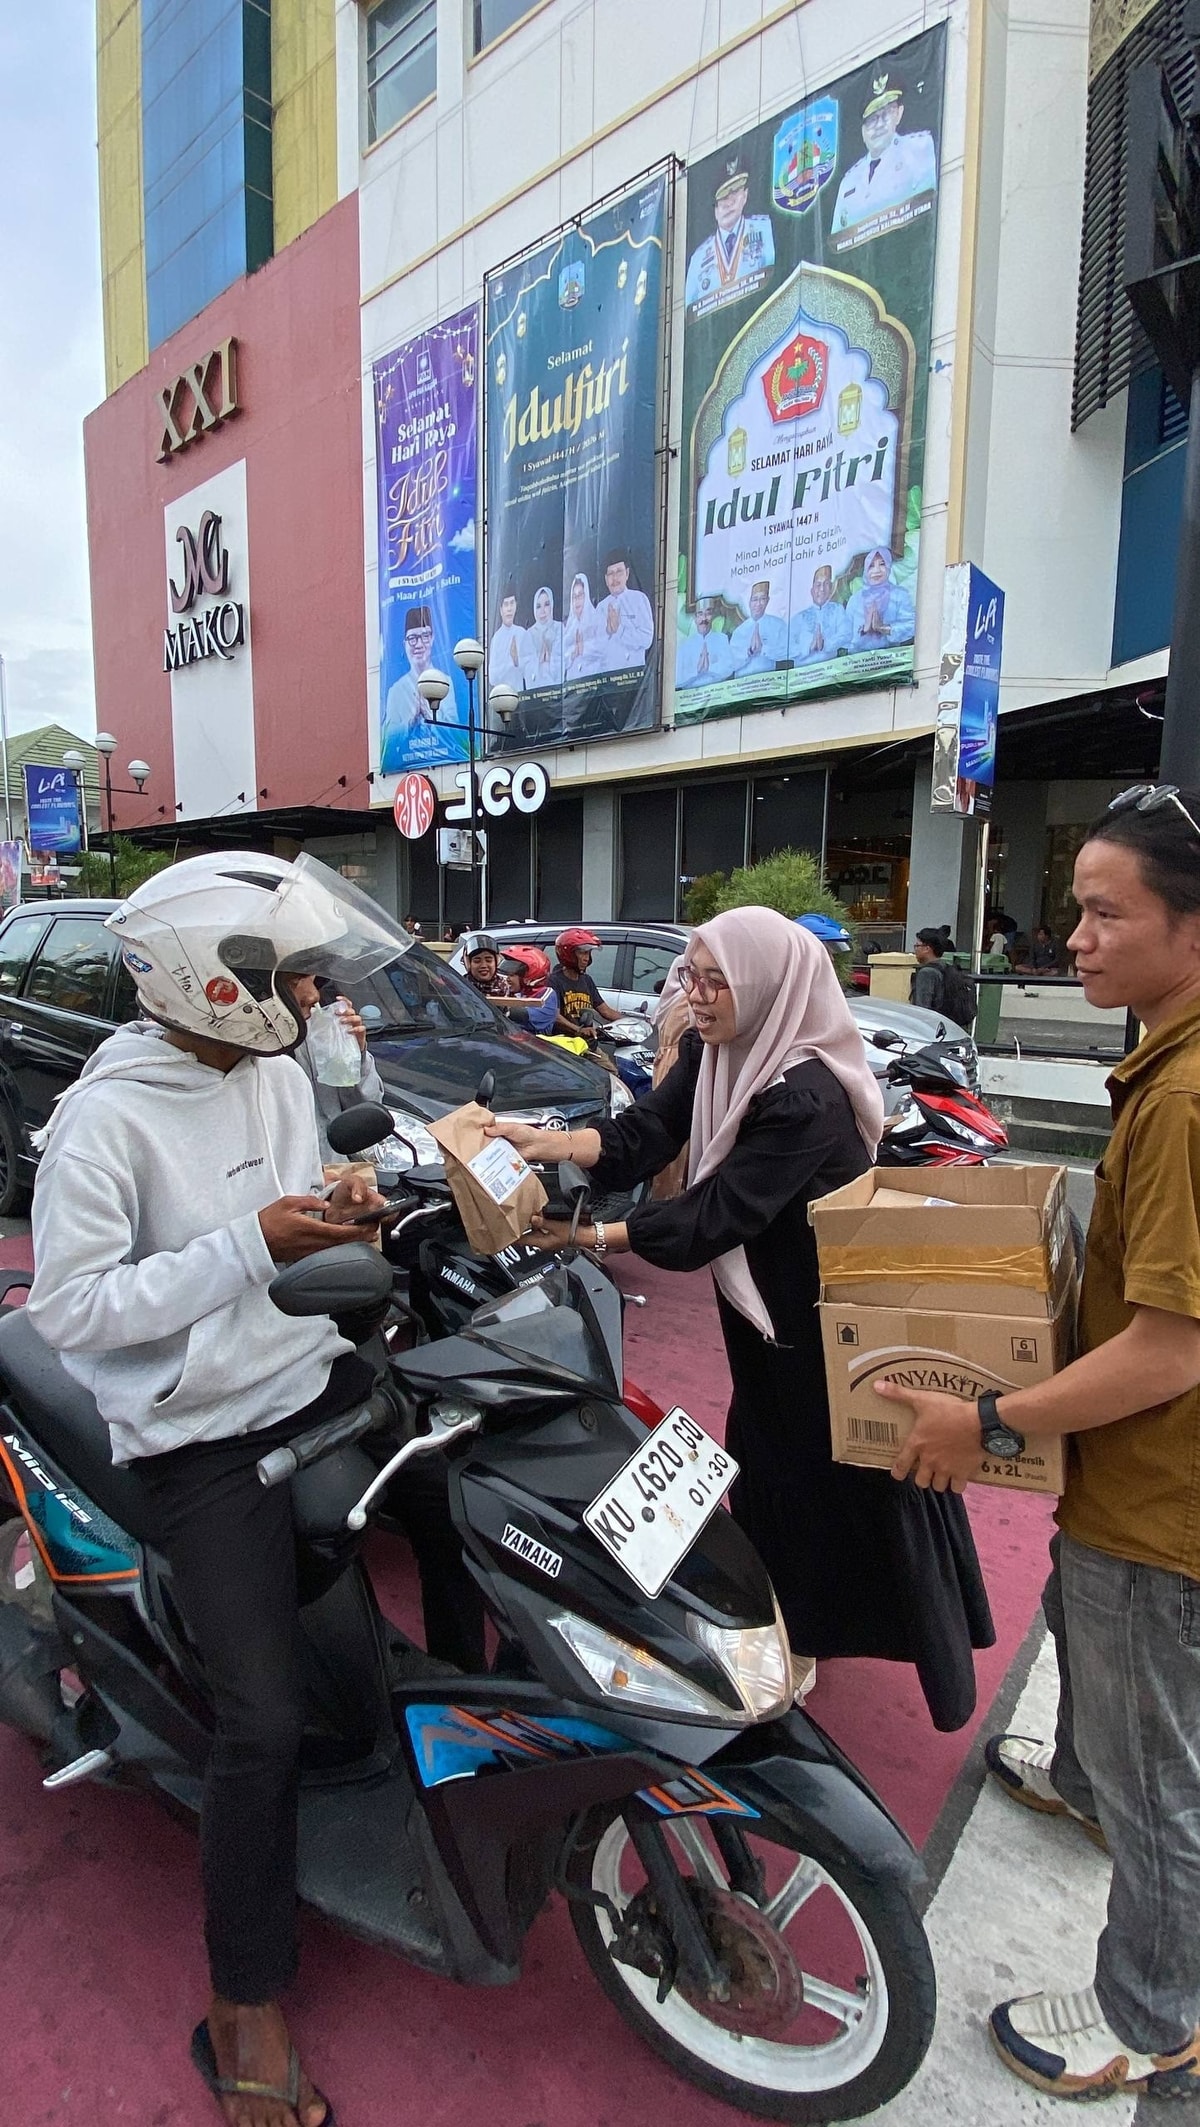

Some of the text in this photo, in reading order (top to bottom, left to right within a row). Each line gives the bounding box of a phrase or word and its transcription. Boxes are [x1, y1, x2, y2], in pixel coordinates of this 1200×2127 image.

[547, 339, 593, 370] Selamat
[153, 336, 238, 463] XXI
[503, 336, 630, 463] Idulfitri
[397, 402, 451, 442] Selamat
[391, 422, 456, 464] Hari Raya
[751, 431, 834, 472] SELAMAT HARI RAYA
[527, 455, 551, 474] Syawal
[386, 450, 448, 522] Idul
[704, 436, 889, 537] Idul Fitri
[768, 518, 795, 536] SYAWAL
[796, 513, 813, 529] 1447
[814, 511, 819, 525] H
[731, 536, 847, 578] Mohon Maaf Lahir & Batin
[735, 550, 761, 563] Minal
[763, 539, 792, 555] Aidzin
[795, 532, 814, 546] Wal
[163, 600, 244, 673] MAKO
[445, 761, 549, 821] J.CO
[498, 1245, 522, 1267] KU
[440, 1265, 475, 1294] YAMAHA
[524, 1271, 545, 1286] YAMAHA
[1020, 1339, 1028, 1350] 6
[981, 1461, 991, 1473] 6
[993, 1464, 1002, 1475] x
[1004, 1463, 1022, 1478] 2L
[55, 1493, 93, 1523] 125
[594, 1497, 636, 1552] KU
[631, 1440, 684, 1502] 4620
[502, 1526, 561, 1578] YAMAHA
